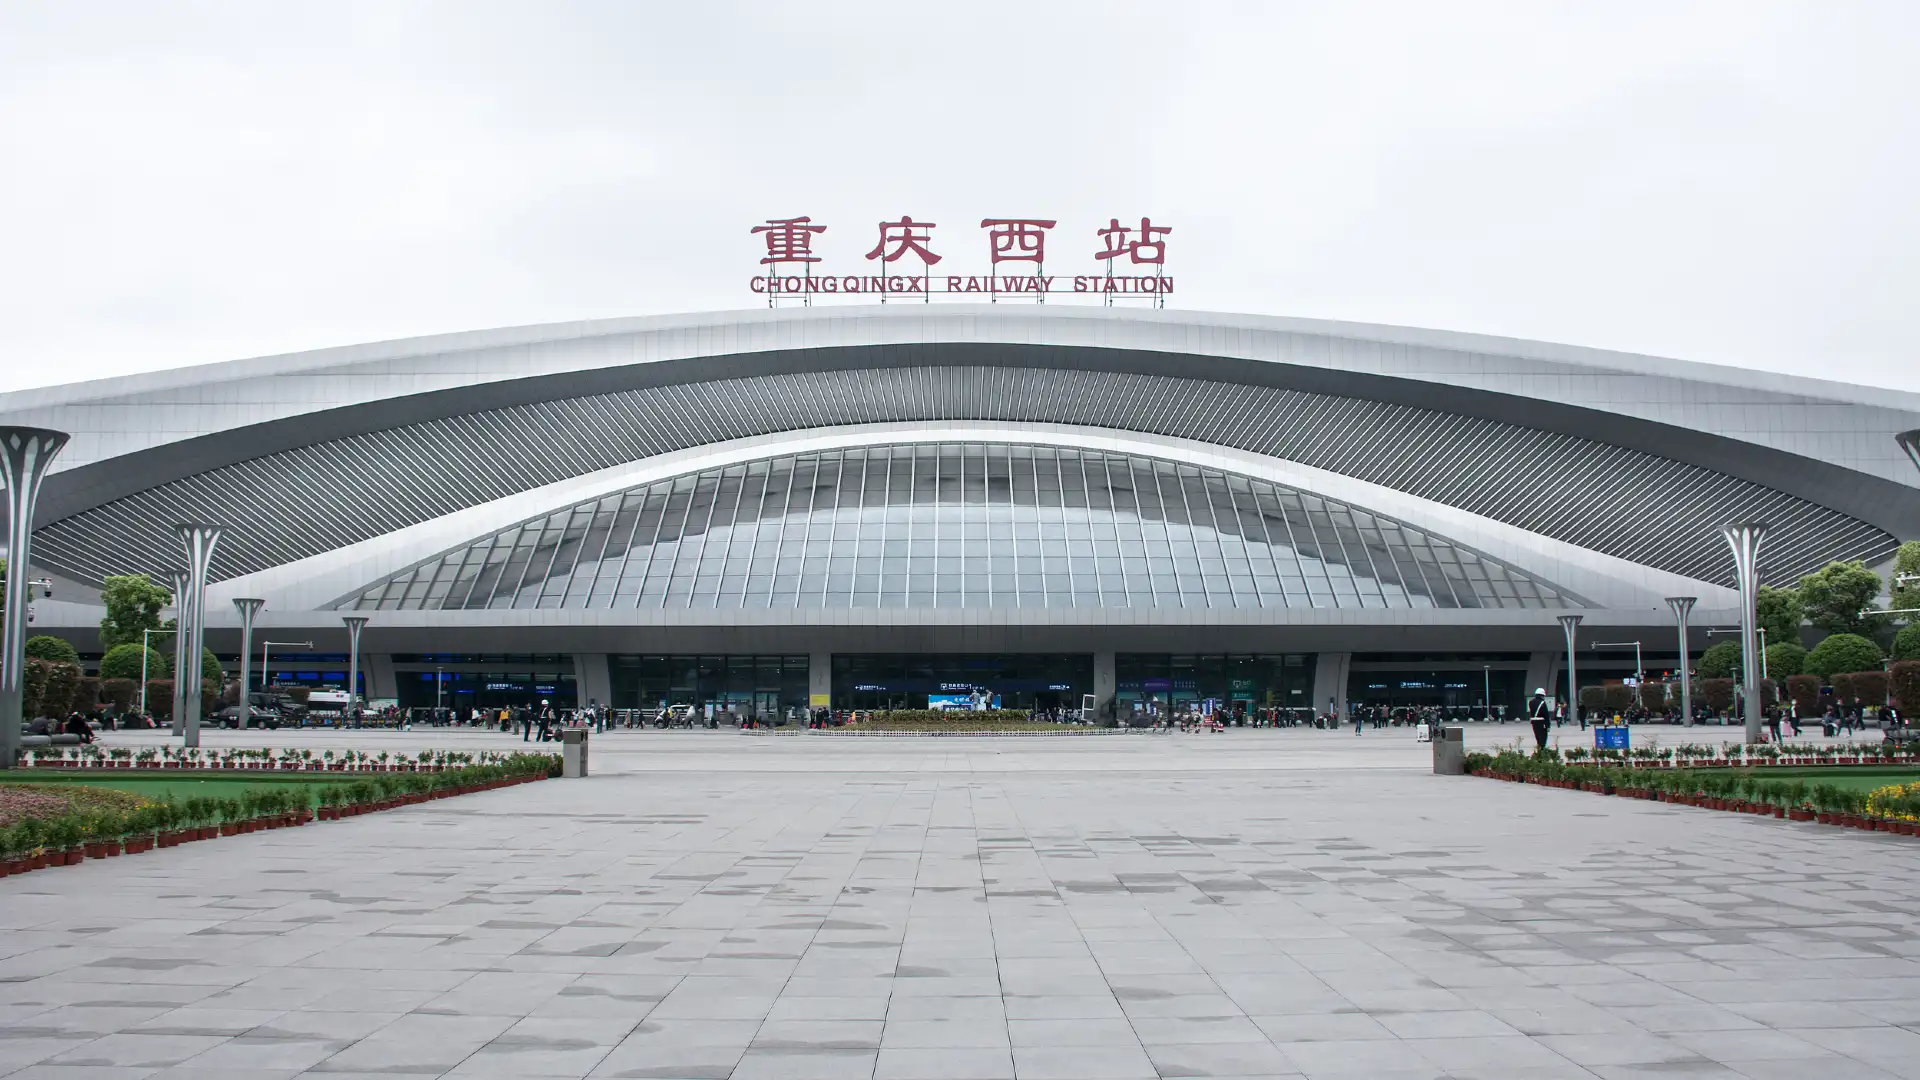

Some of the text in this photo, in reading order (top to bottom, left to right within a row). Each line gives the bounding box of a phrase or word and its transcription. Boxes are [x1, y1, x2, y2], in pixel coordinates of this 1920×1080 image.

[750, 216, 1173, 265] 重庆西站
[750, 275, 1173, 293] CHONGQINGXI RAILWAY STATION
